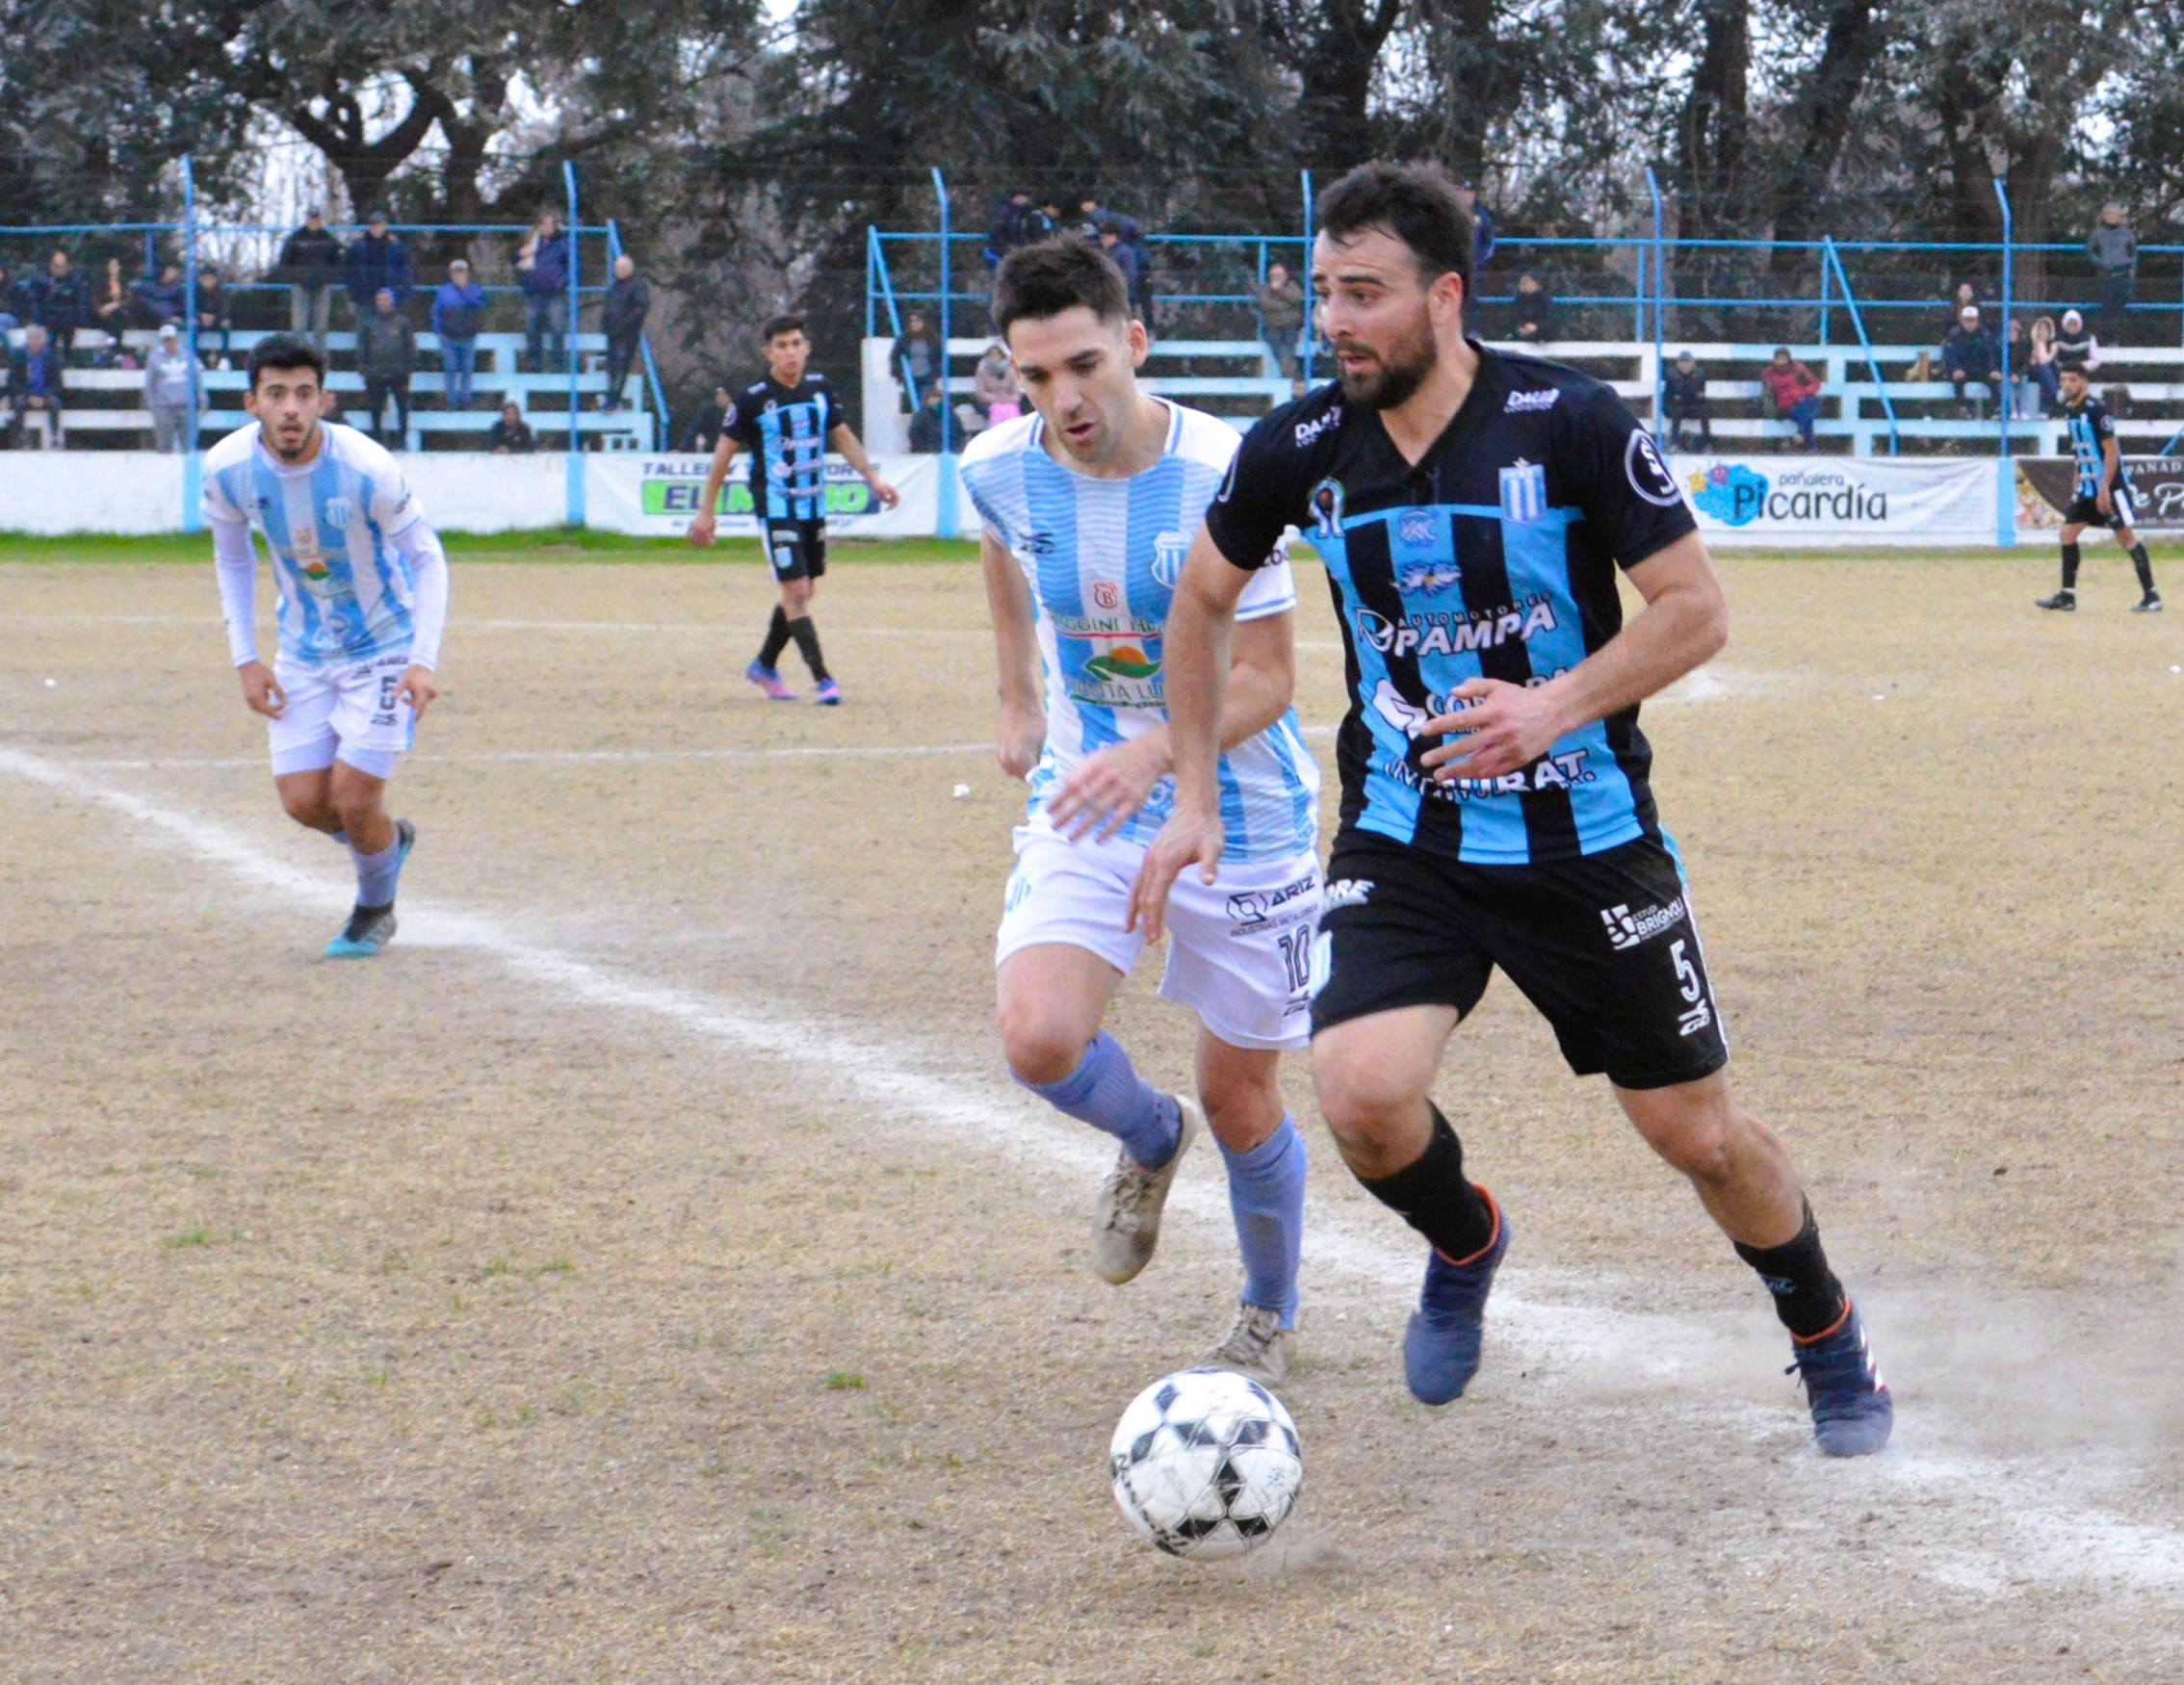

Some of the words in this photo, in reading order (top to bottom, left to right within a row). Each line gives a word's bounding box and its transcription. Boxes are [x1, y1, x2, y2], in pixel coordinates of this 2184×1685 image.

[1734, 482, 1887, 521] Picardía
[1779, 472, 1845, 489] pañalera
[1393, 602, 1556, 657] PAMPA
[1277, 923, 1312, 994] 10
[1670, 938, 1702, 1002] 5
